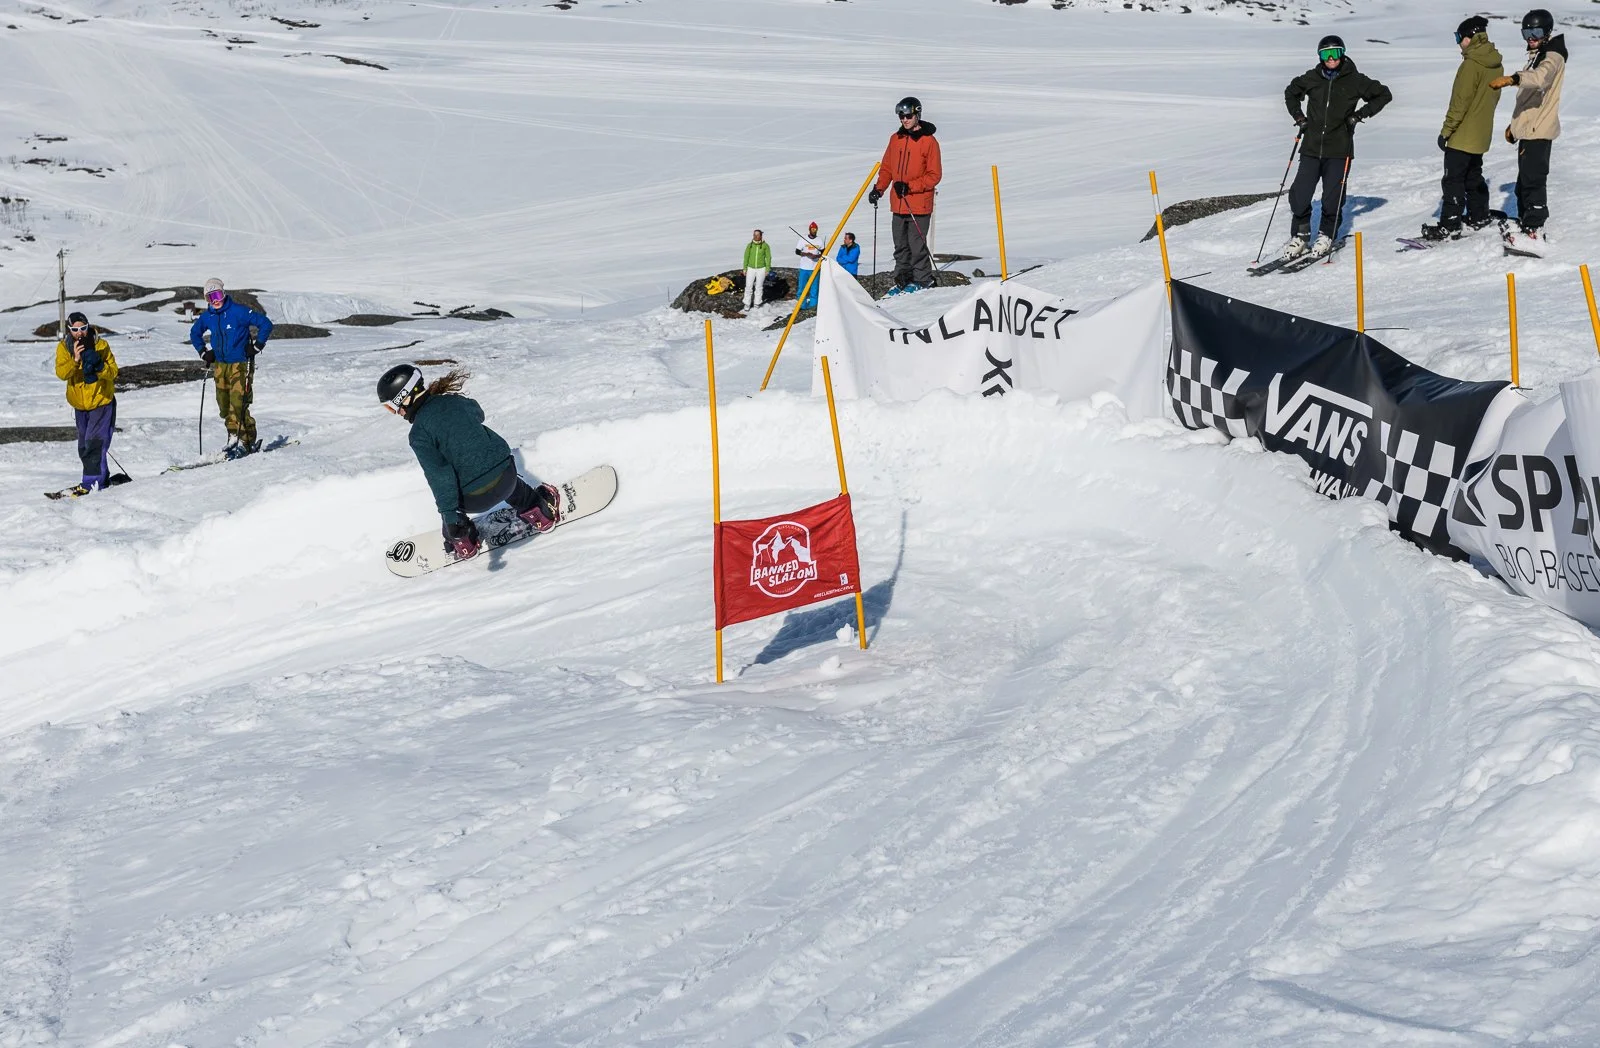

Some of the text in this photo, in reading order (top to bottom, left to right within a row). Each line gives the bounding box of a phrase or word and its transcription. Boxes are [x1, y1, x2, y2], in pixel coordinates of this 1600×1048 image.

[1265, 372, 1373, 467] VANS
[754, 560, 799, 580] BANKED
[769, 567, 813, 587] SLALOM
